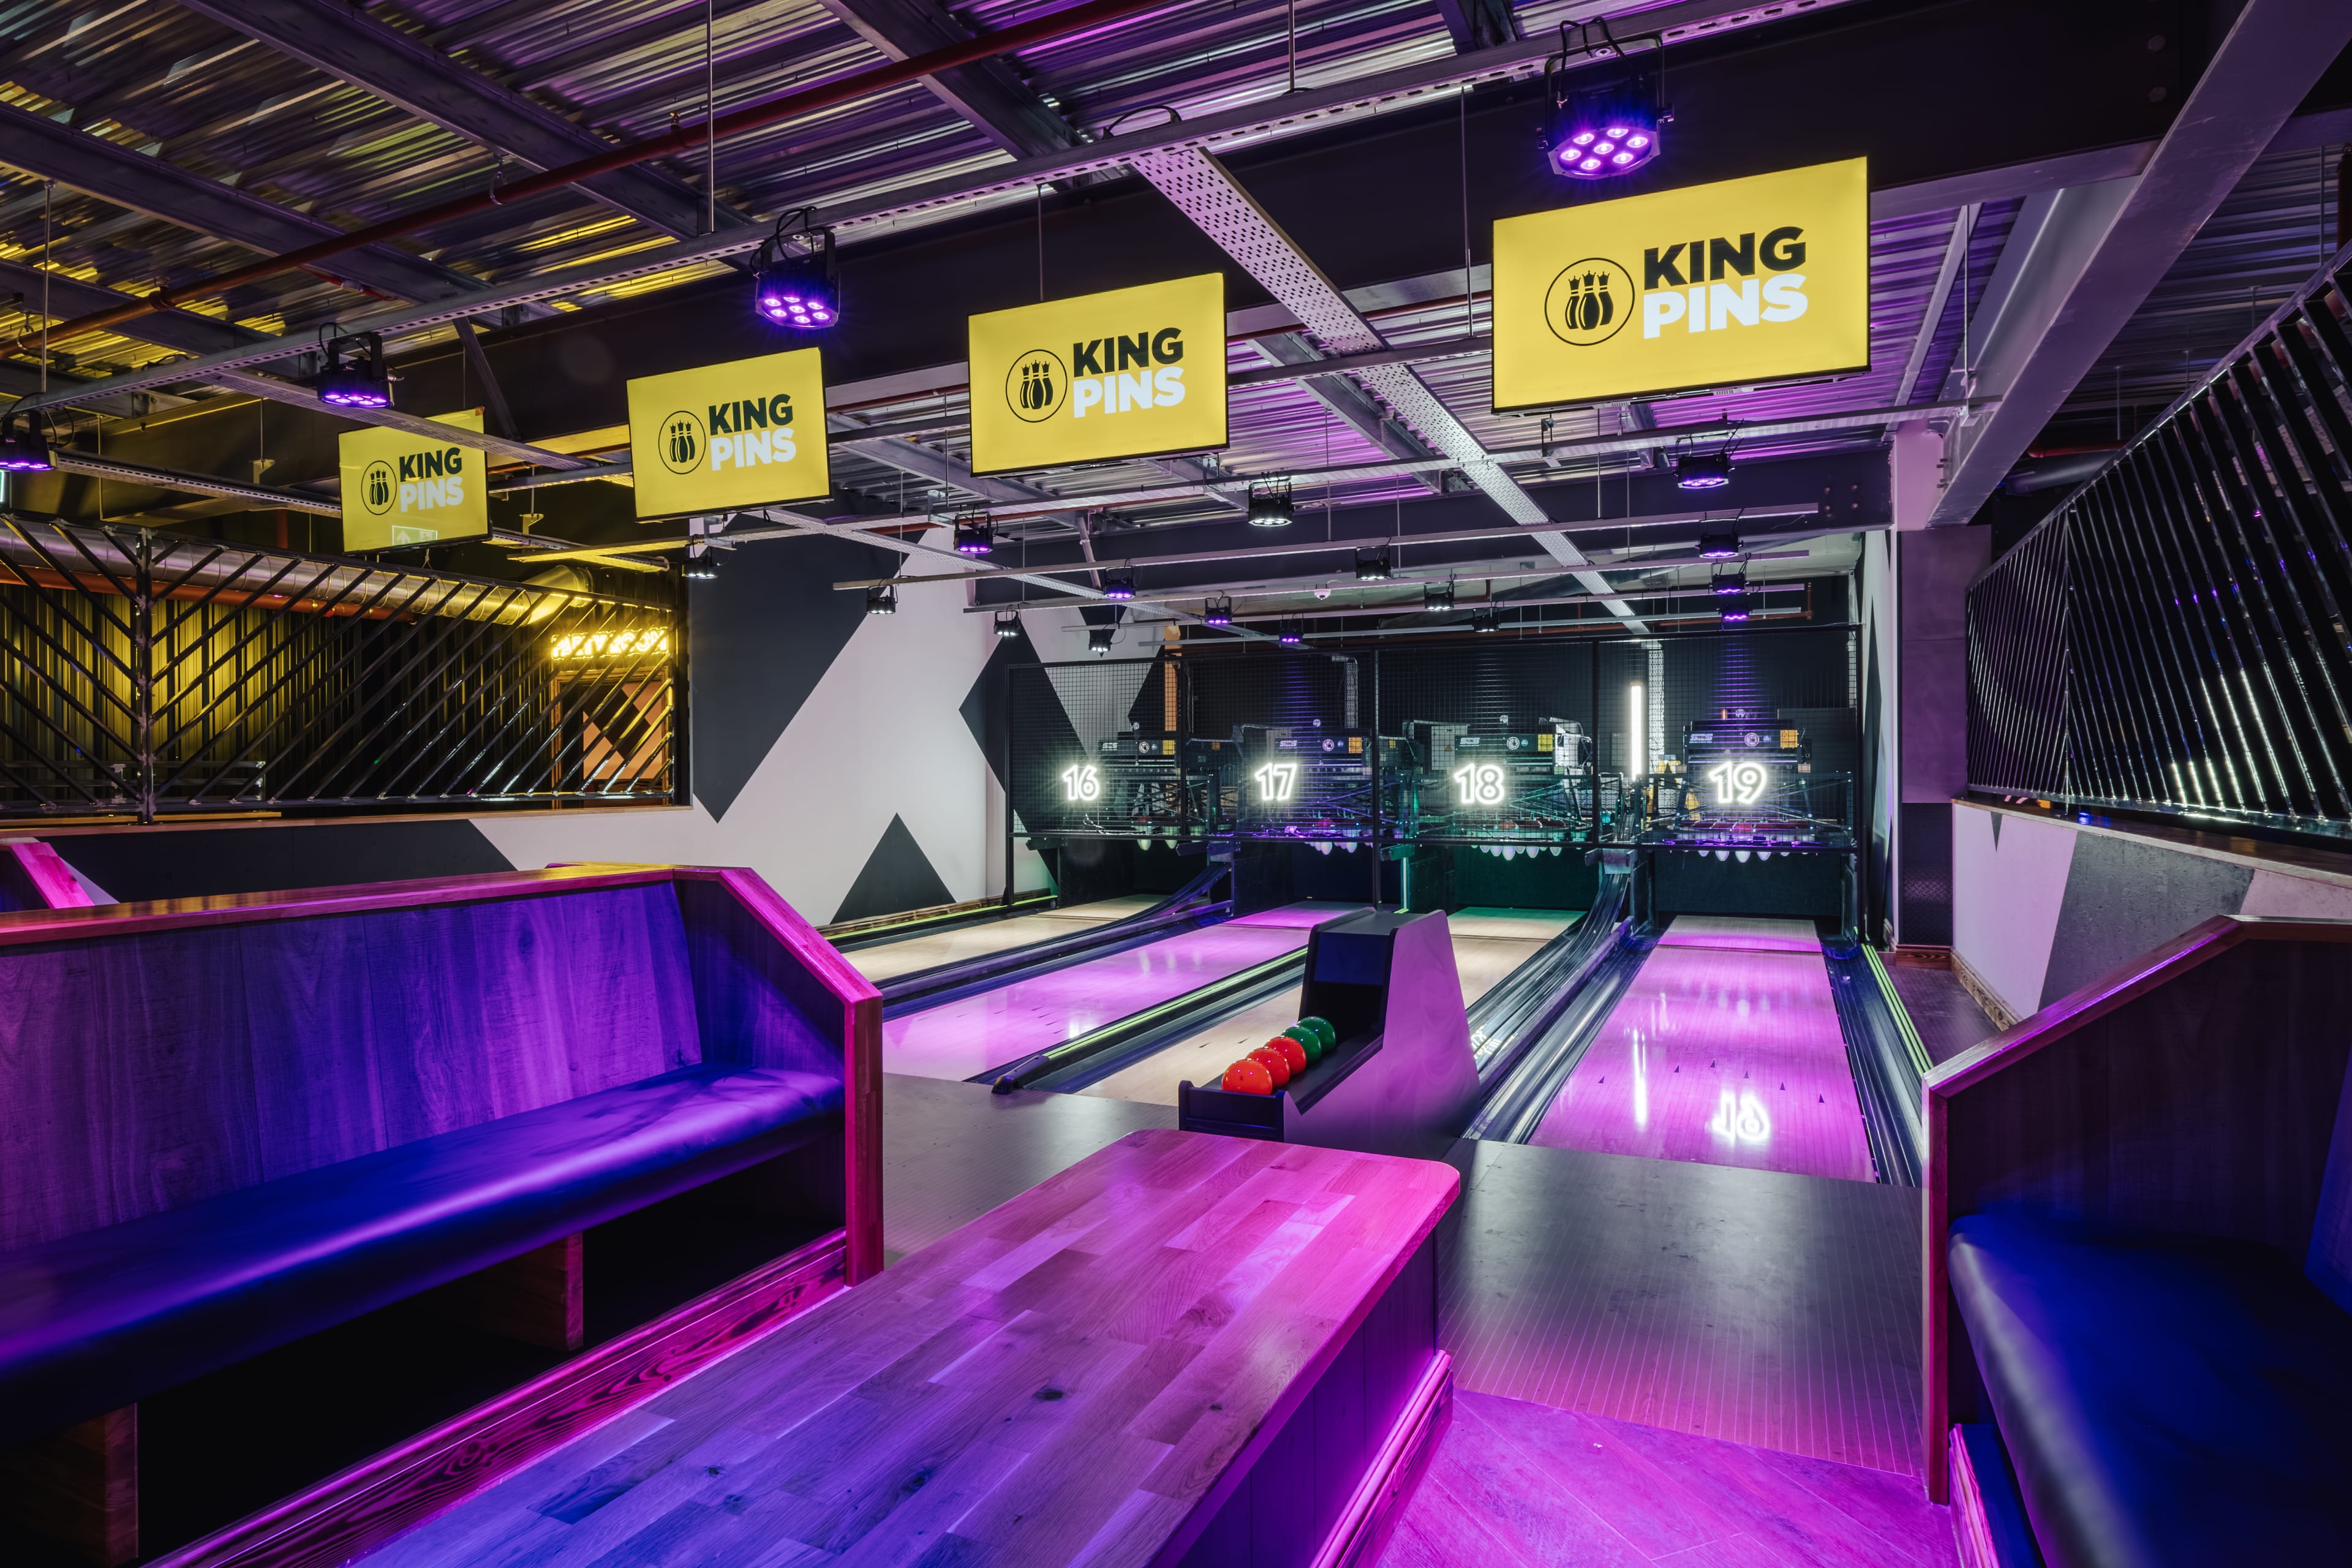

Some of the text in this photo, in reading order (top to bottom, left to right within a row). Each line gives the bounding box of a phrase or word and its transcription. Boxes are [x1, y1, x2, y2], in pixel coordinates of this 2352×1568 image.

[1644, 226, 1806, 290] KING
[1643, 273, 1809, 340] PINS
[1073, 327, 1184, 377] KING
[1073, 366, 1186, 418] PINS
[708, 394, 794, 435] KING
[399, 447, 462, 482] KING
[710, 428, 797, 471] PINS
[399, 476, 464, 513] PINS
[552, 629, 668, 658] PARTY ROOM
[1063, 764, 1099, 801] 16
[1254, 763, 1297, 801] 17
[1453, 763, 1504, 805] 18
[1709, 760, 1767, 805] 19
